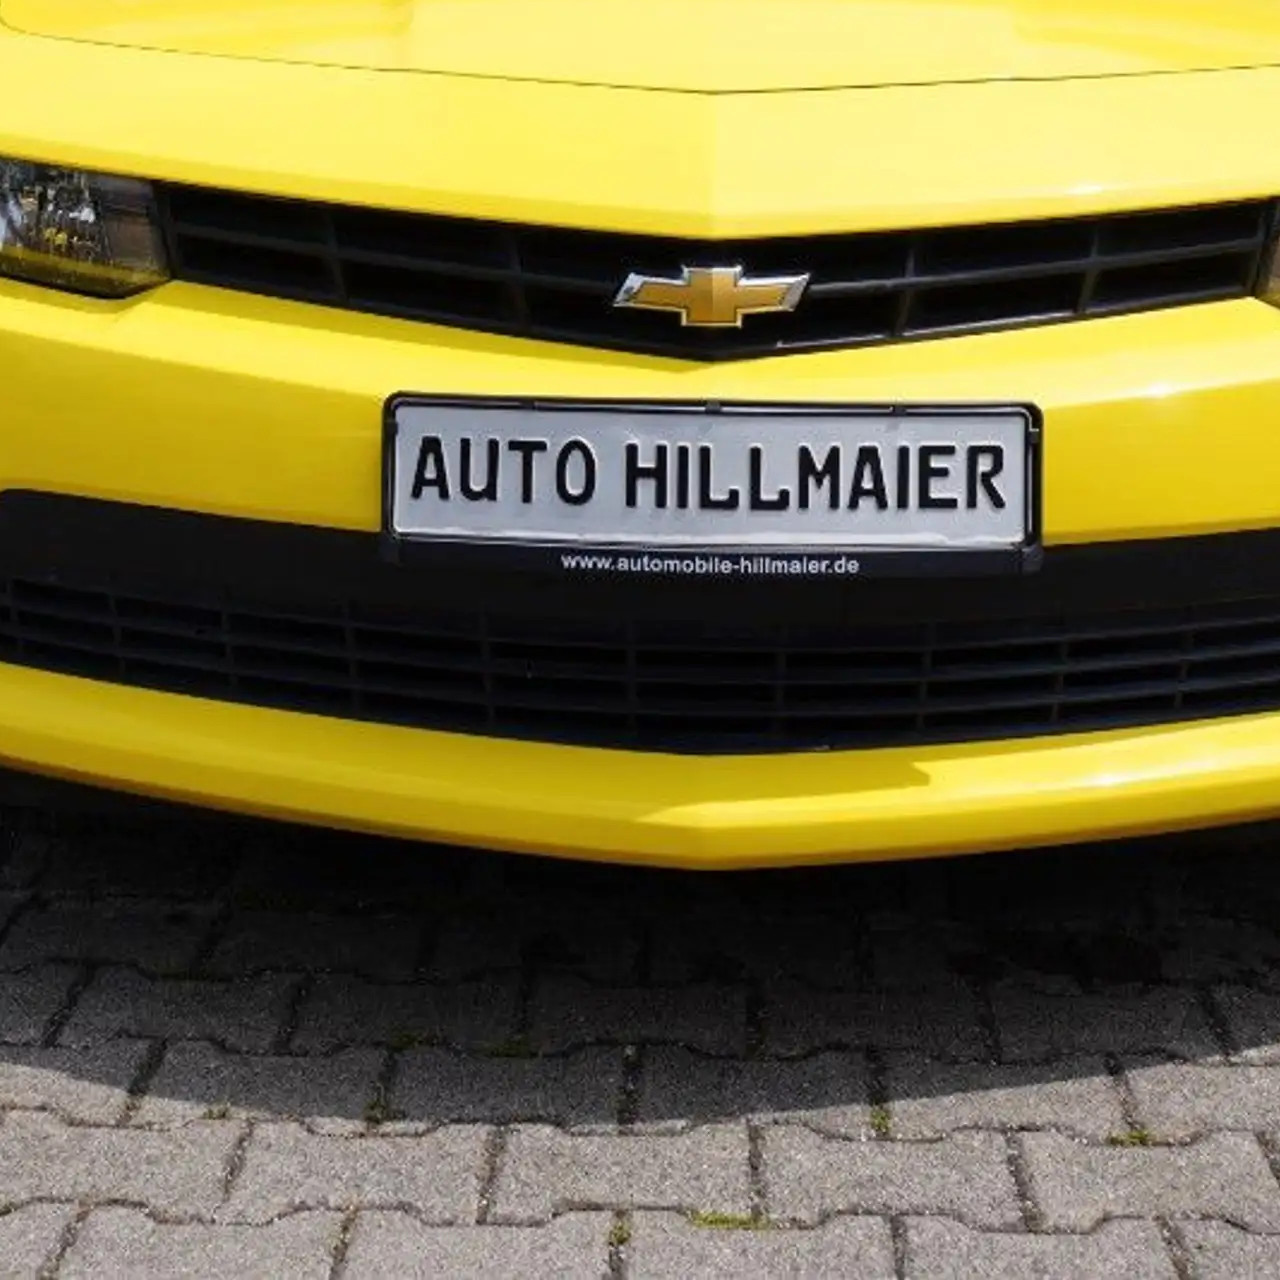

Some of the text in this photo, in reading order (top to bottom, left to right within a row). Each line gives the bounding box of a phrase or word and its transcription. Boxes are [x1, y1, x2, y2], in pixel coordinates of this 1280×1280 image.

[410, 435, 1006, 511] AUTO HILLMAIER
[560, 552, 860, 574] www.automobile-hillmaier.de
